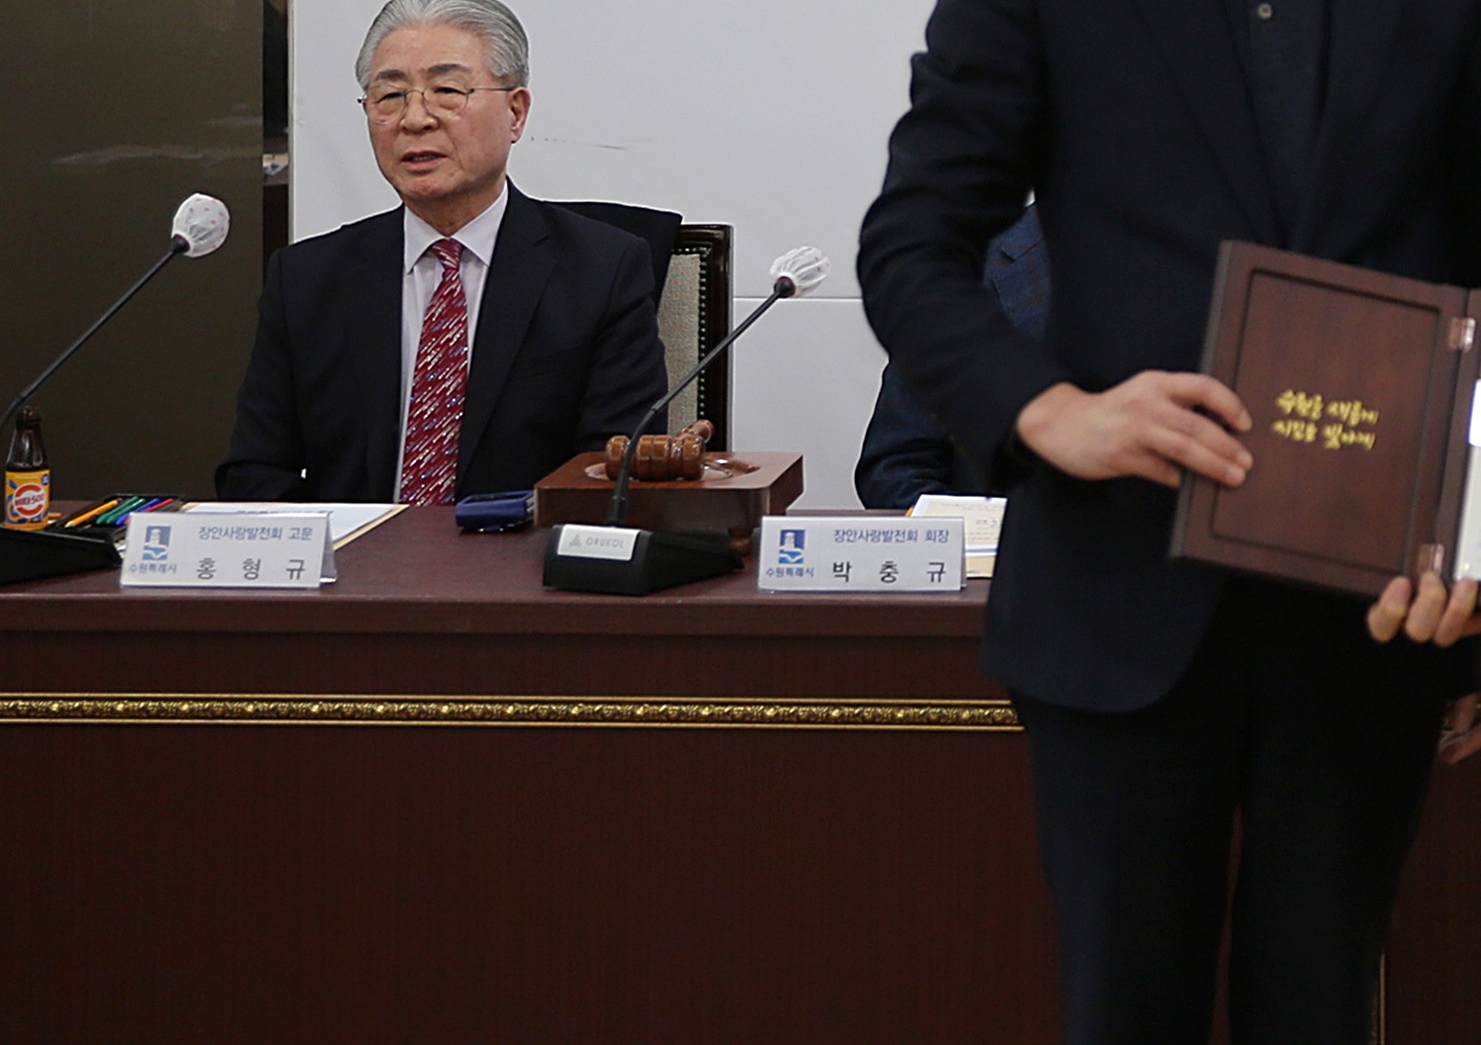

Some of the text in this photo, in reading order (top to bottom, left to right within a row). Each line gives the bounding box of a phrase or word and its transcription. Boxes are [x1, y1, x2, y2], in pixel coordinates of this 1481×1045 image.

[198, 525, 313, 541] 장안사랑발전회 고문
[833, 528, 918, 543] 장안사랑발전회
[925, 529, 950, 544] 회장
[129, 562, 177, 575] 수원특례시
[766, 567, 815, 579] 수원특례시
